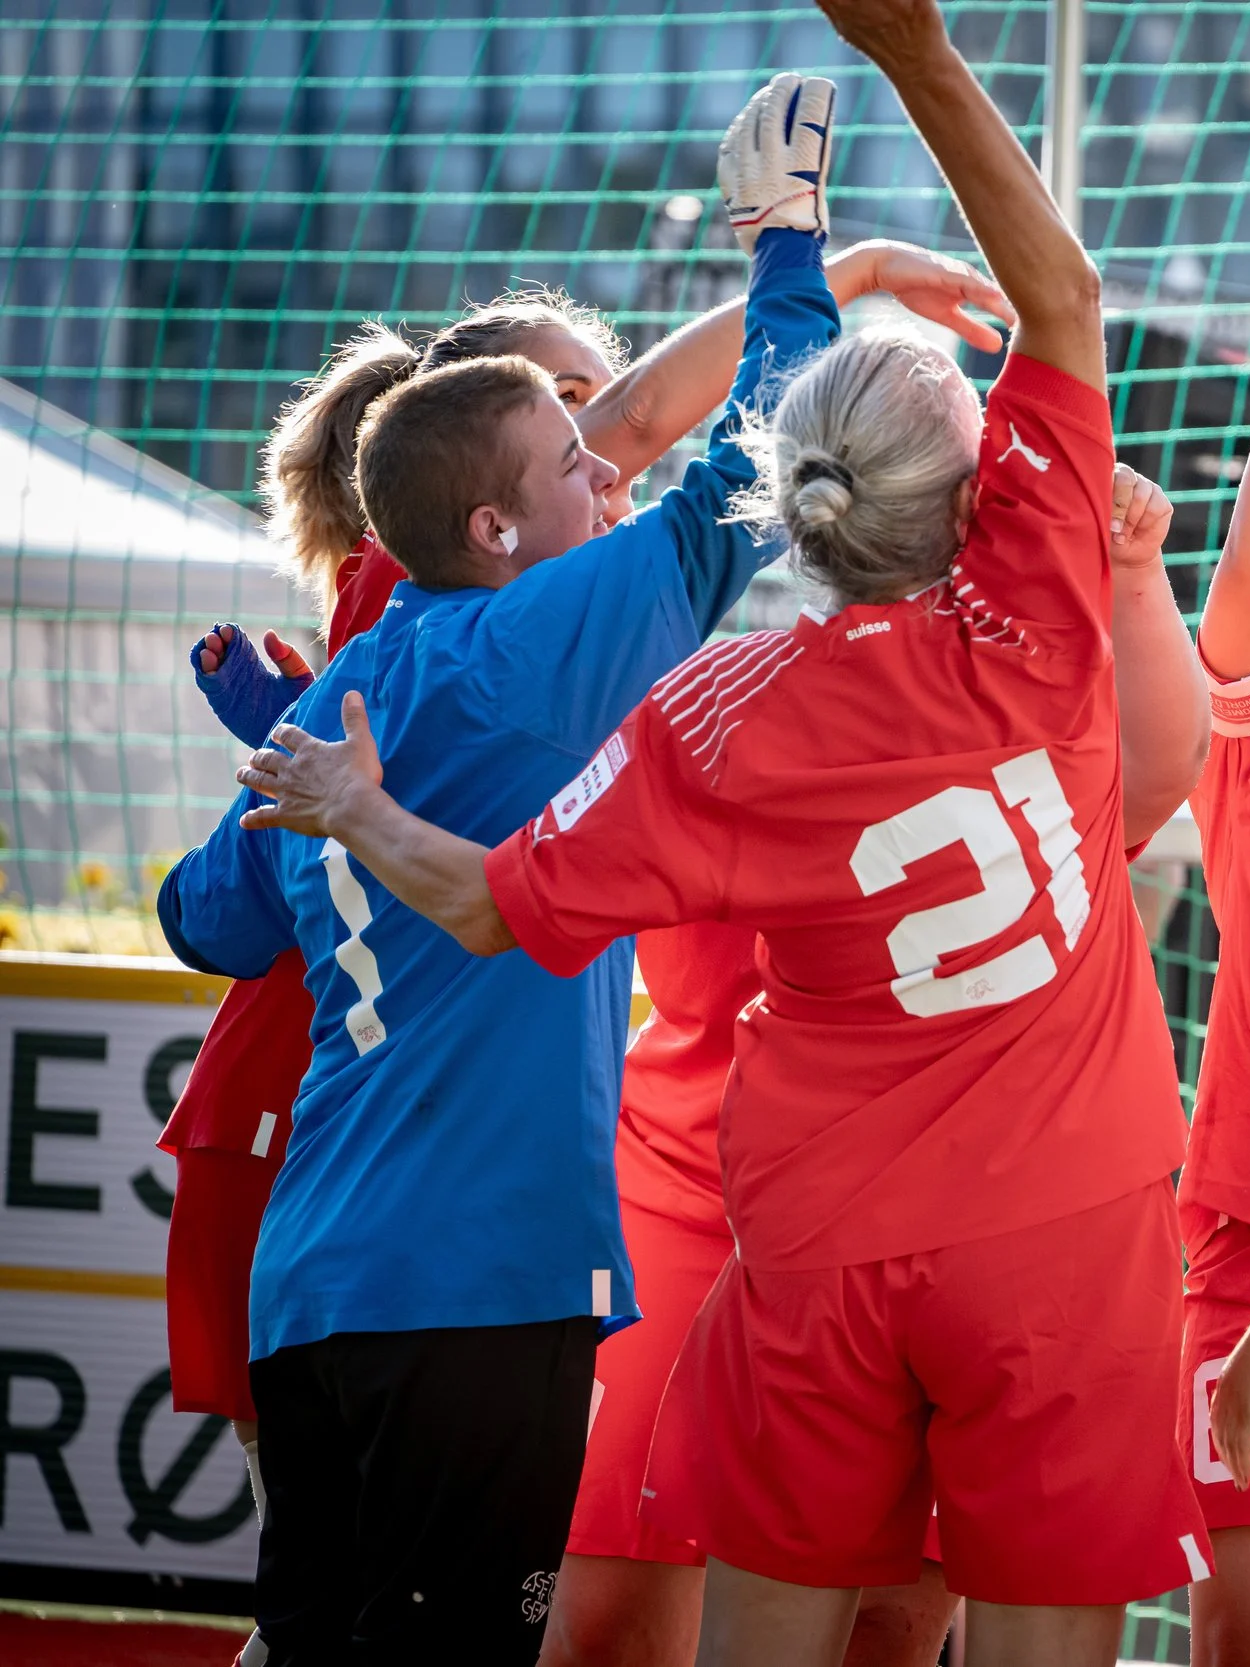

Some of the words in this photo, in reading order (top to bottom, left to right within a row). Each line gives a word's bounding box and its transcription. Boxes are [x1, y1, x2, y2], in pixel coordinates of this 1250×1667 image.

[846, 621, 891, 641] suisse
[318, 836, 387, 1057] 1
[849, 748, 1091, 1018] 21
